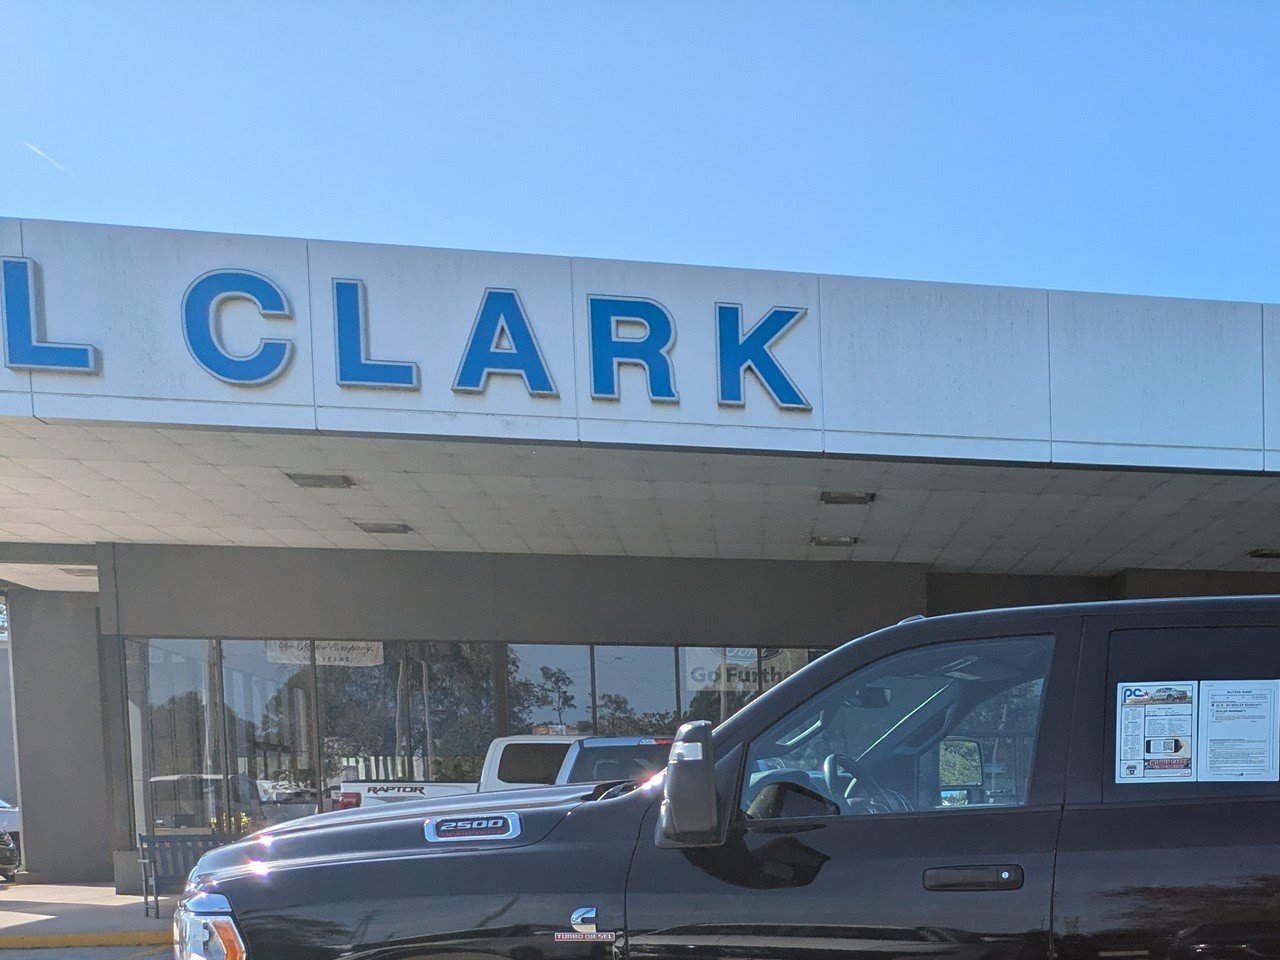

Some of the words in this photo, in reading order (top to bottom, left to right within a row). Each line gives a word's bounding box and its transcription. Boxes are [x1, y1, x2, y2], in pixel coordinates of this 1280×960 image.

[182, 267, 812, 411] CLARK
[690, 666, 721, 683] Go
[726, 666, 797, 683] Furthe
[367, 786, 426, 796] RAPTOR
[441, 819, 504, 831] 2500
